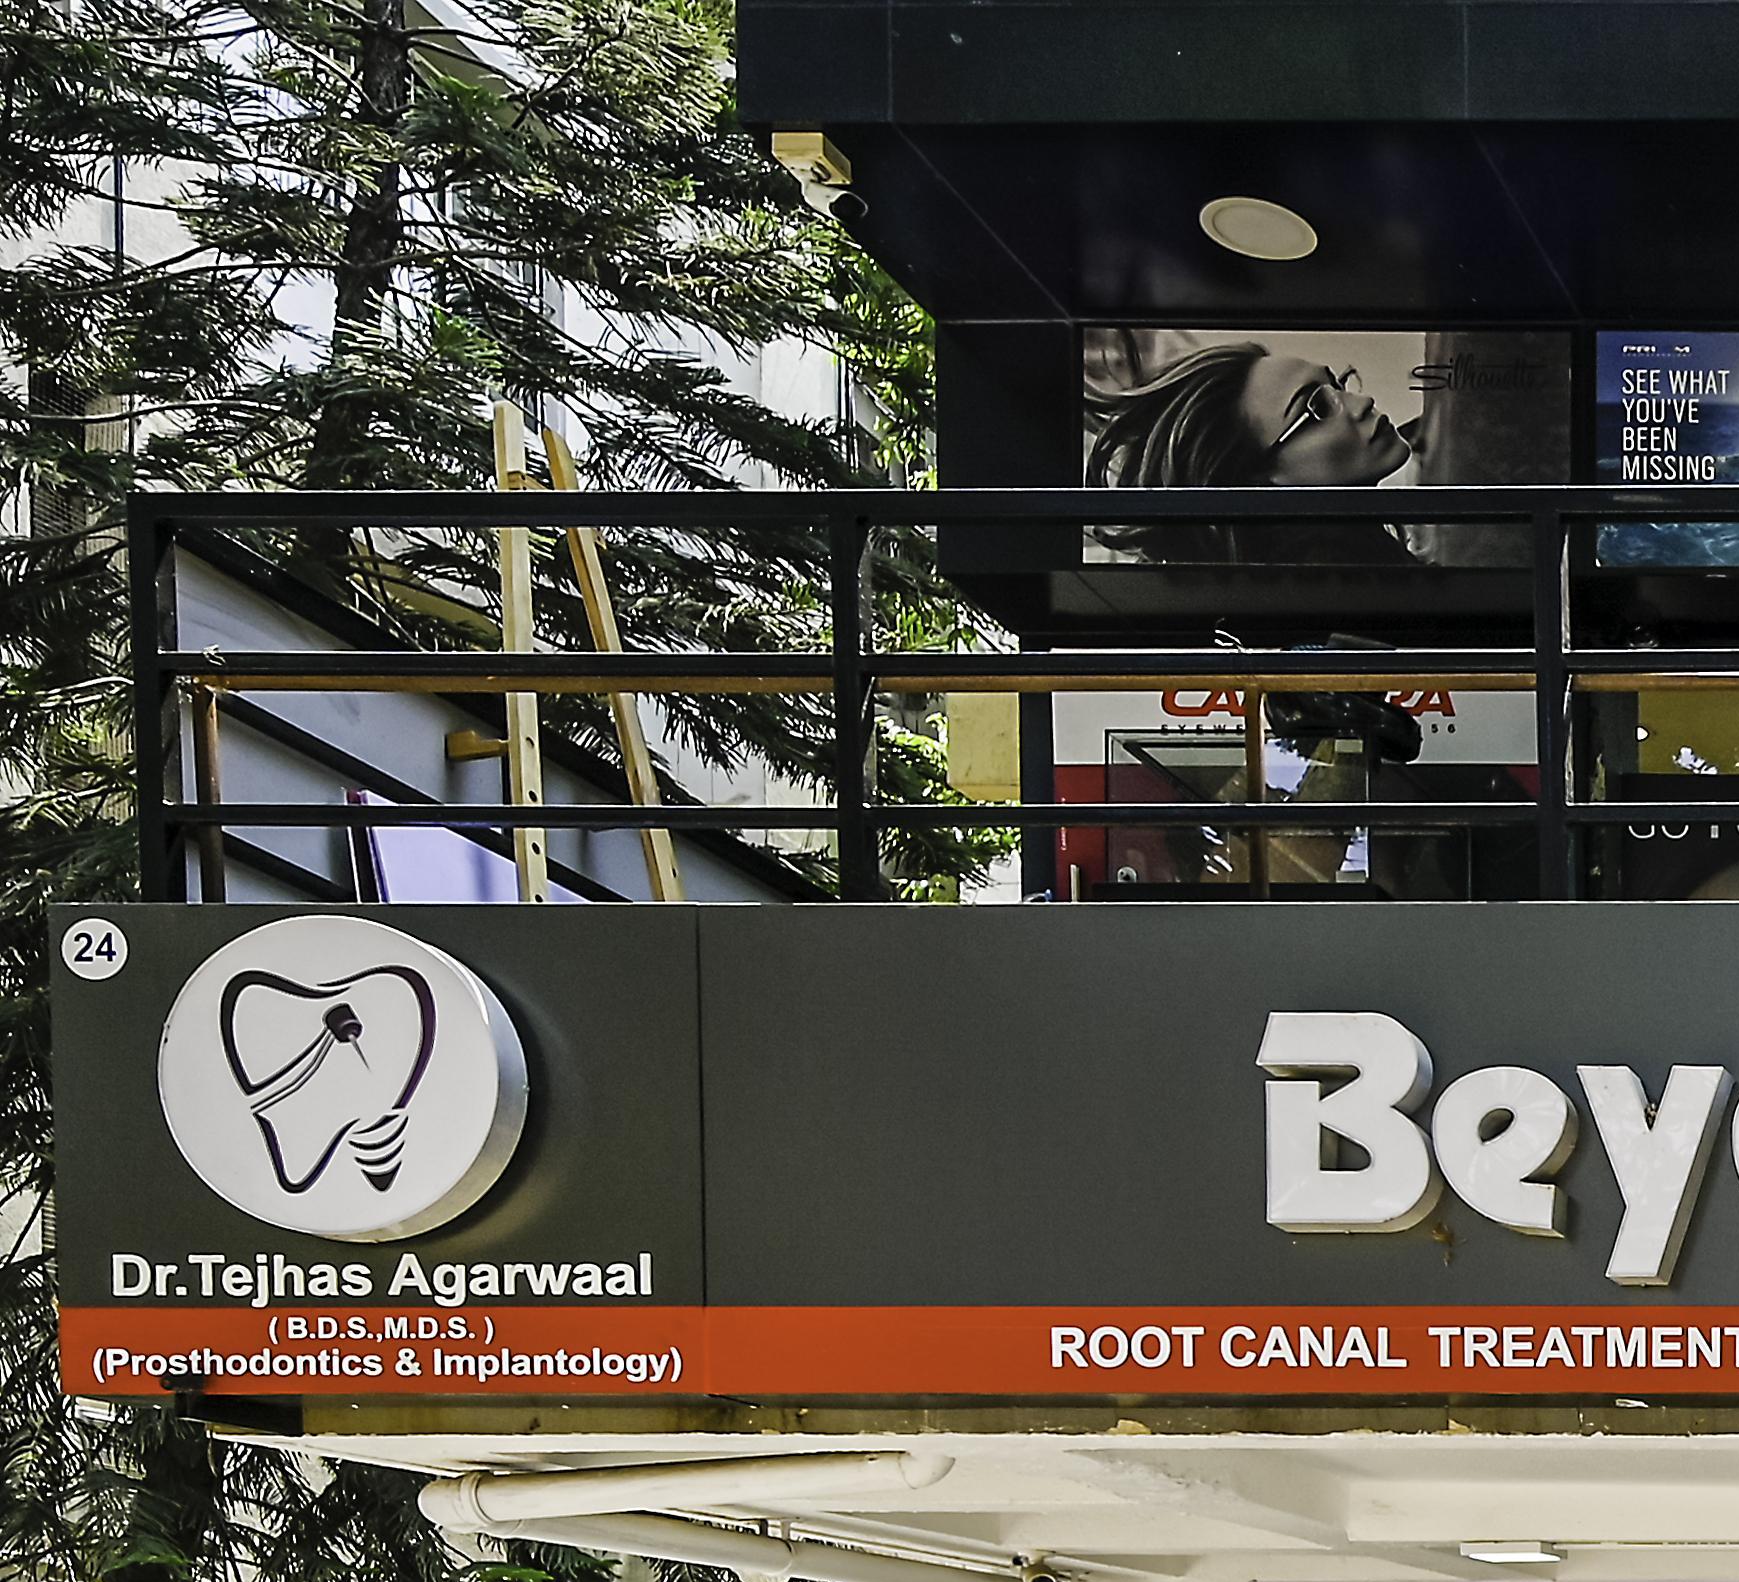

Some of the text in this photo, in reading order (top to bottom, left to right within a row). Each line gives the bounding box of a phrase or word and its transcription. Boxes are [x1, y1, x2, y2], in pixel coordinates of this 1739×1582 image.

[1621, 369, 1730, 395] SEE WHAT
[1621, 398, 1700, 423] YOU'VE
[1622, 426, 1677, 452] BEEN
[1622, 455, 1715, 480] MISSING
[73, 933, 117, 962] 24
[111, 1253, 653, 1306] Dr.Tejhas Agarwaal
[1050, 1325, 1205, 1367] ROOT
[1219, 1325, 1407, 1367] CANAL
[92, 1347, 682, 1383] (Prosthodontics & Implantology)
